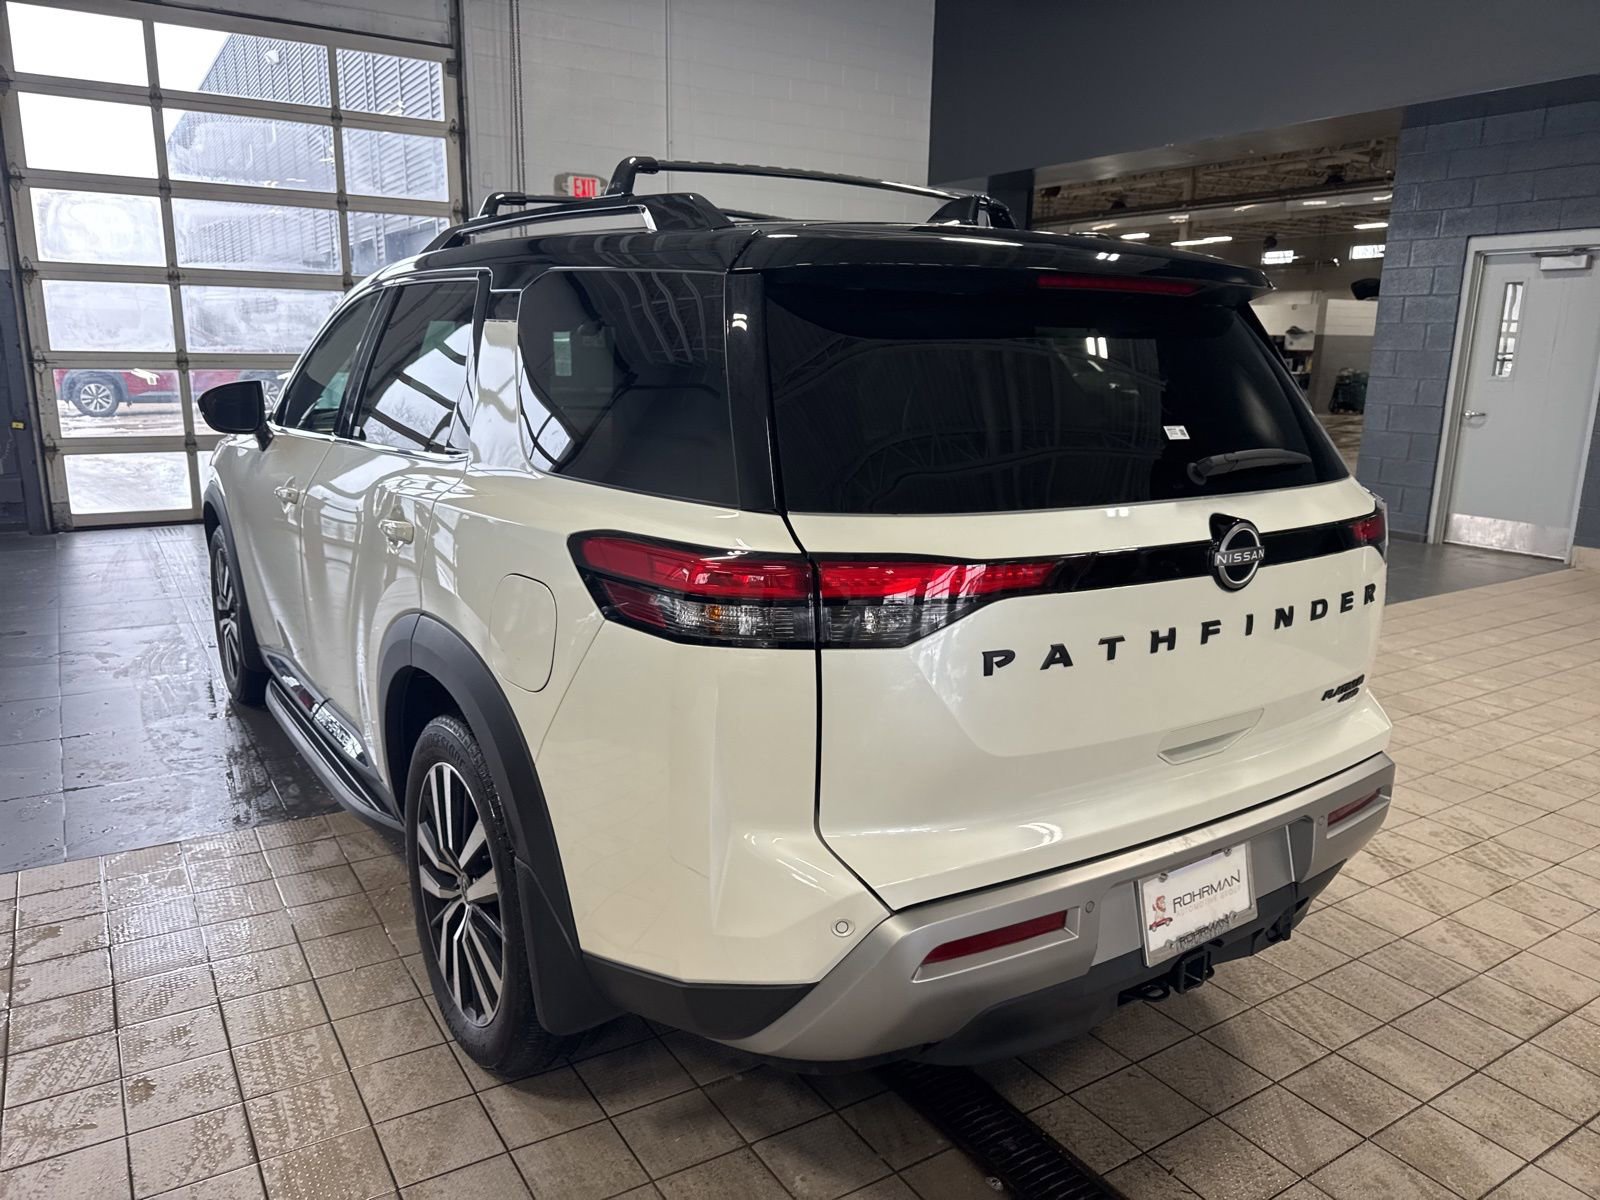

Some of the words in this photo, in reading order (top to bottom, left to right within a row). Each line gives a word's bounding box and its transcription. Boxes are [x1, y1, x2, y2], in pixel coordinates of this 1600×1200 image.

[574, 176, 597, 198] EXIT
[1217, 548, 1265, 564] NISSAN
[982, 583, 1376, 677] PATHFINDER
[1172, 868, 1240, 914] ROHRMAN
